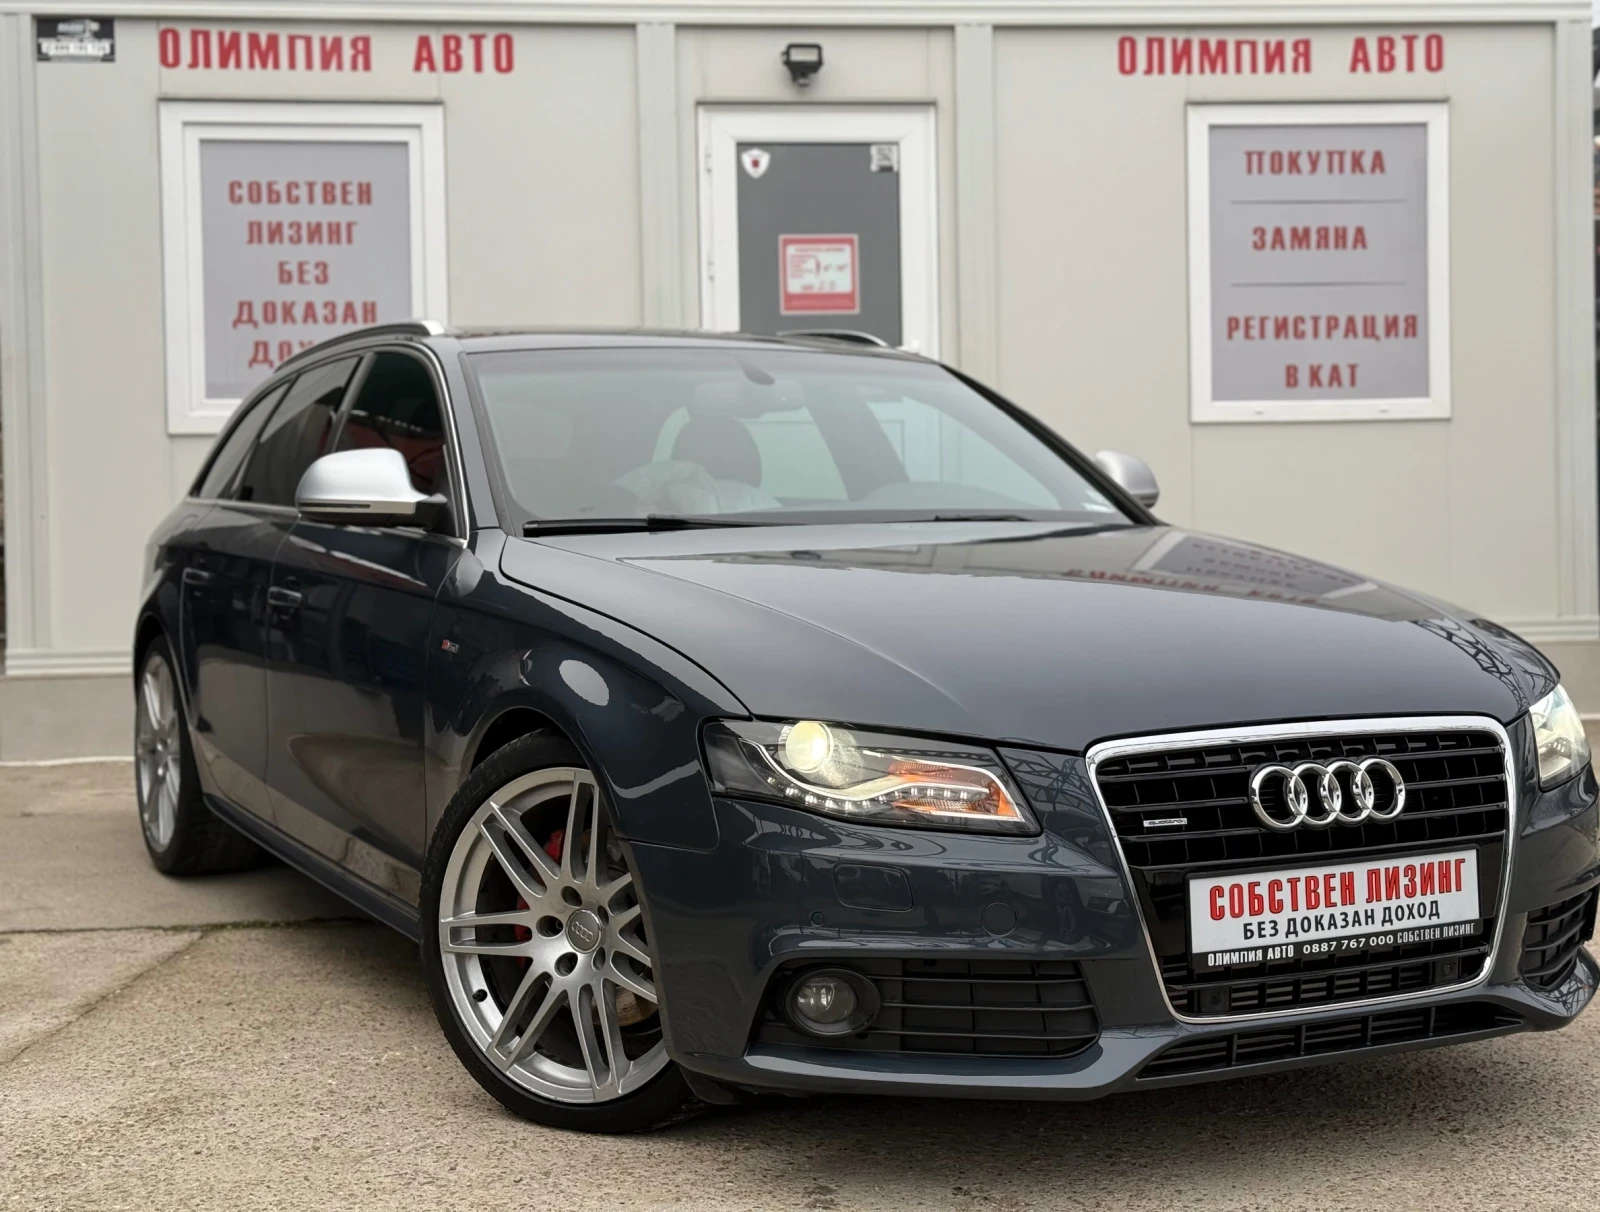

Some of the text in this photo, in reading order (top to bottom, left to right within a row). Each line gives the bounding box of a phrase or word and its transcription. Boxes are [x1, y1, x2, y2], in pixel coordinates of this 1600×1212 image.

[158, 27, 373, 72] ОЛИМПИЯ
[412, 33, 516, 74] АВТО
[1117, 33, 1445, 76] ОЛИМПИЯ АВТО
[1245, 149, 1387, 175] ПОКУПКА
[228, 180, 374, 206] СОБСТВЕН
[246, 220, 359, 246] ЛИЗИНГ
[1252, 226, 1368, 251] ЗАМЯНА
[277, 260, 330, 286] БЕЗ
[232, 300, 378, 329] ДОКАЗАН
[1227, 314, 1419, 341] РЕГИСТРАЦИЯ
[1285, 364, 1360, 389] В КАТ
[1209, 858, 1466, 921] СОБСТВЕН ЛИЗИНГ
[1243, 900, 1440, 941] БЕЗ ДОКАЗАН ДОХОД
[1207, 922, 1476, 967] ОЛИМПИЯ АВТО 0887 767 000 СОБСТВЕН ЛИЗИНГ
